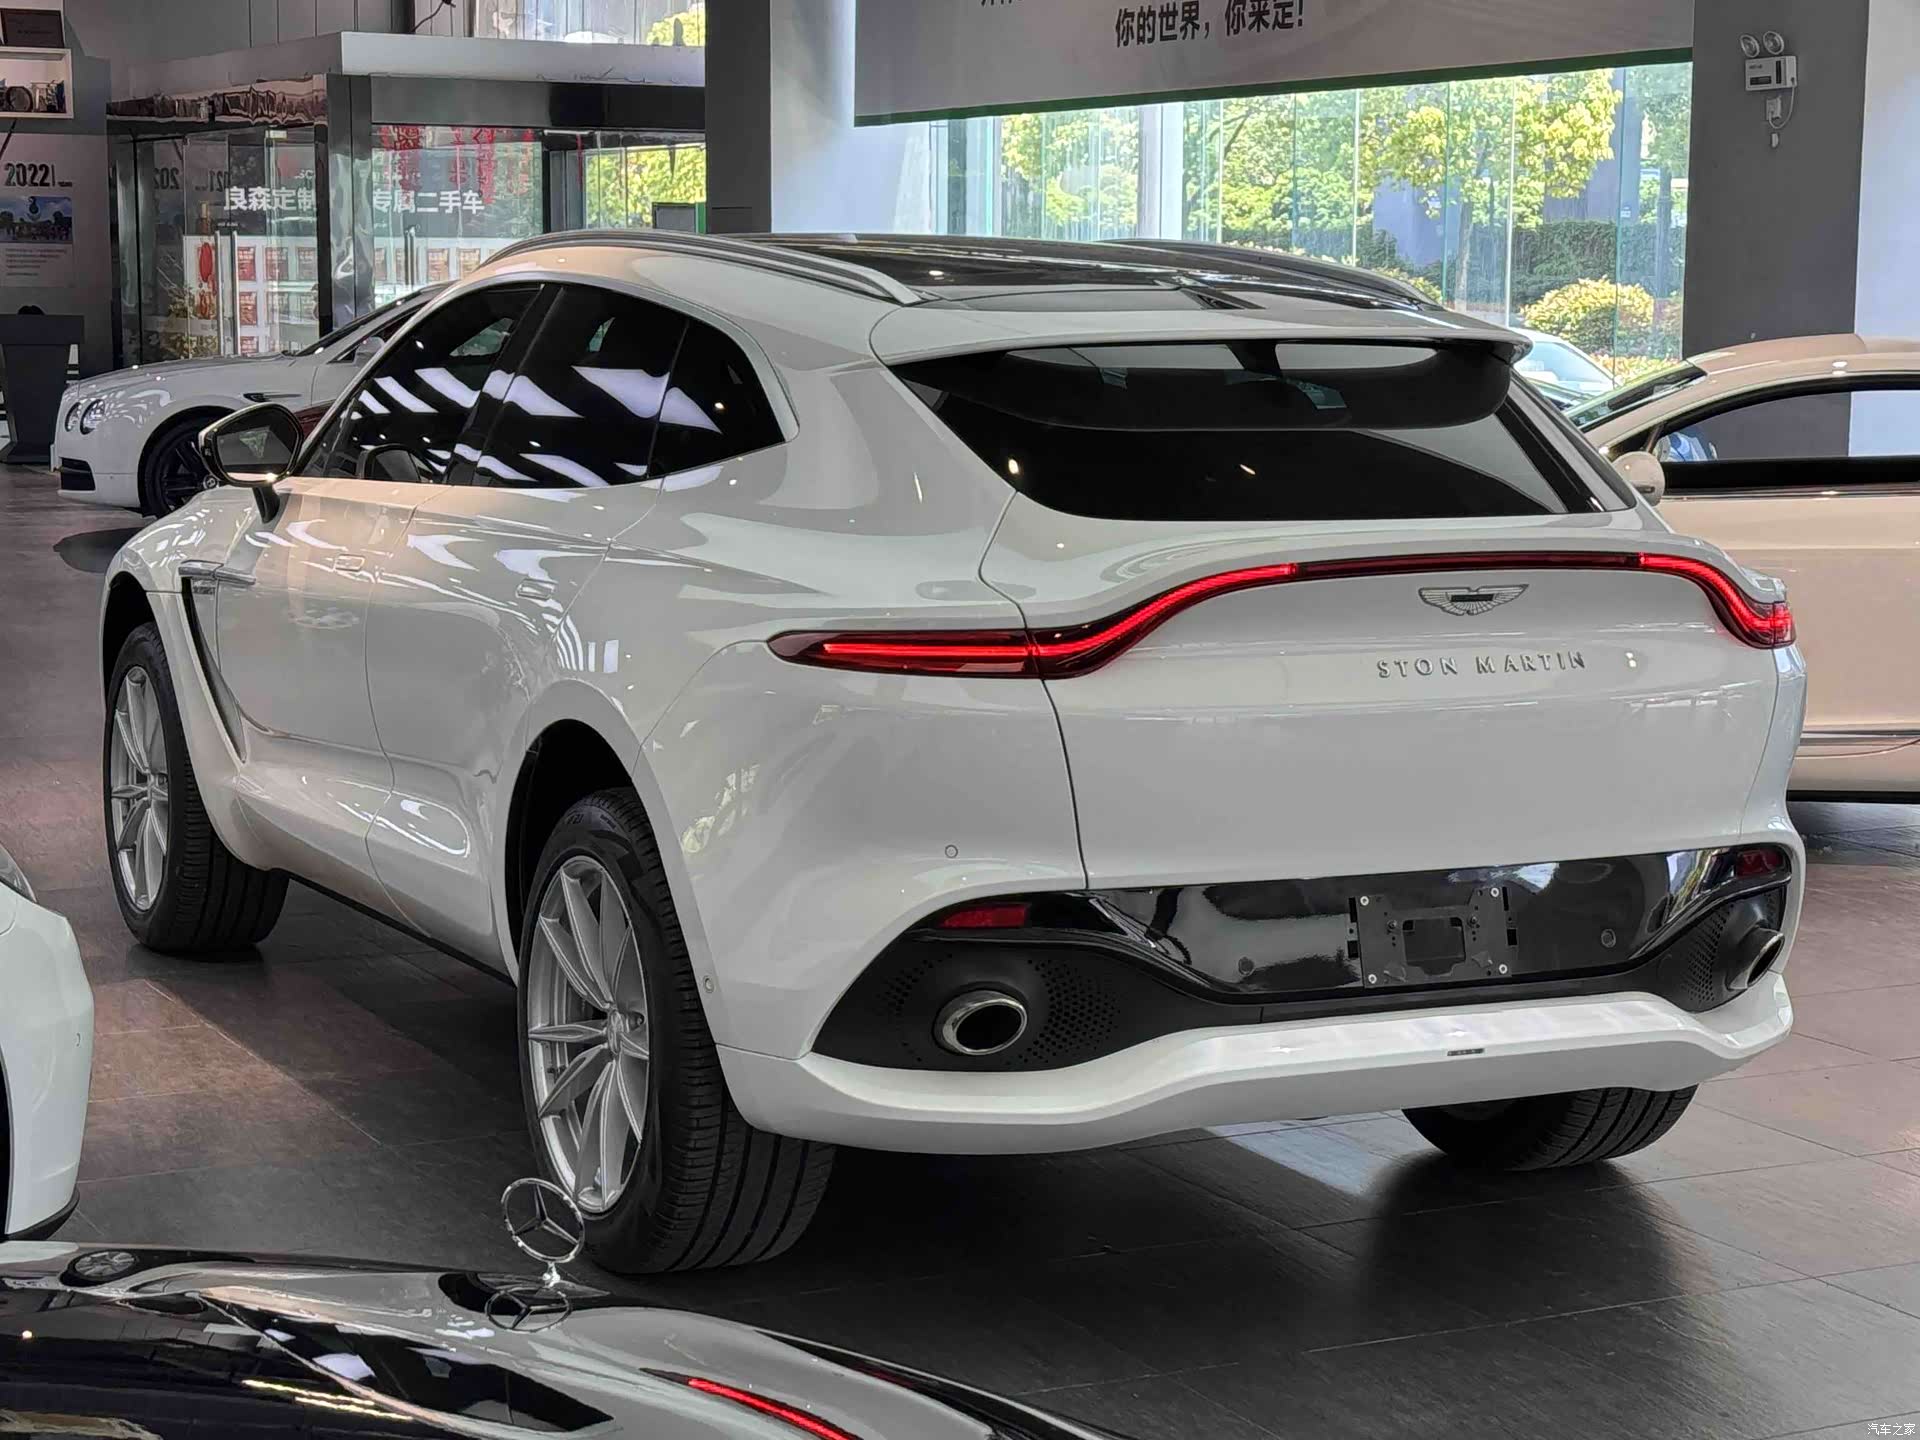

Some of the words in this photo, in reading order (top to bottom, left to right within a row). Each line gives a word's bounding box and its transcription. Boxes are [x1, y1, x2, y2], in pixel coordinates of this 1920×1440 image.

[4, 162, 51, 187] 2022
[372, 189, 486, 215] 专属二手车
[1376, 656, 1459, 678] STON
[1475, 650, 1586, 674] MARTIN
